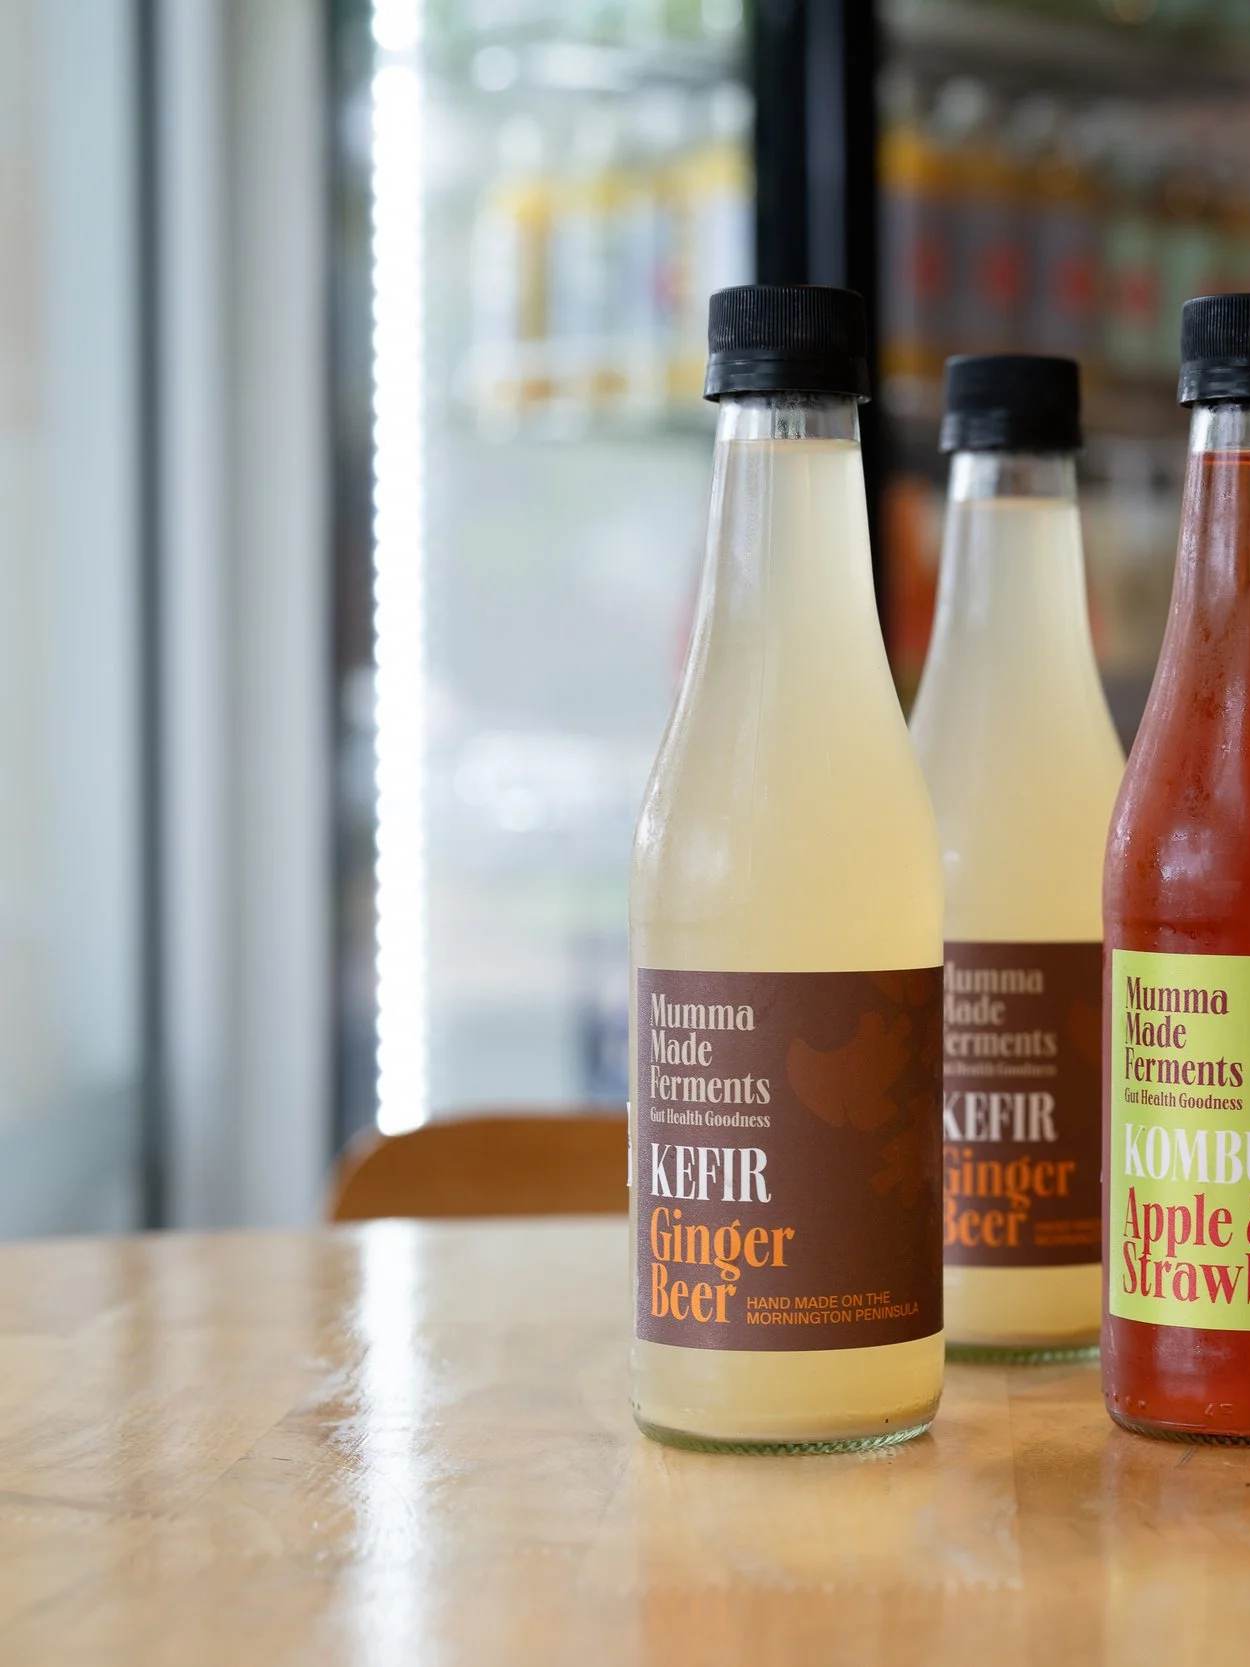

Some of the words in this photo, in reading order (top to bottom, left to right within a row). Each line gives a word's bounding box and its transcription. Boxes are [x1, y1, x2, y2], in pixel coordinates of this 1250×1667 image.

[650, 992, 755, 1030] Mumma
[1125, 975, 1229, 1016] Mumma
[650, 1029, 712, 1066] Made
[1125, 1011, 1187, 1049] Made
[650, 1065, 770, 1104] Ferments
[1124, 1047, 1243, 1088] Ferments
[650, 1106, 665, 1123] Gut
[667, 1108, 703, 1126] Health
[705, 1110, 771, 1128] Goodness
[1124, 1087, 1139, 1104] Gut
[1141, 1089, 1177, 1108] Health
[1179, 1092, 1243, 1111] Goodness
[650, 1142, 771, 1203] KEFIR
[1123, 1186, 1233, 1258] Apple
[650, 1206, 796, 1281] Ginger
[650, 1262, 737, 1323] Beer
[747, 1296, 791, 1310] HAND
[794, 1295, 838, 1309] MADE
[841, 1294, 863, 1308] ON
[865, 1291, 891, 1306] THE
[747, 1310, 852, 1325] MORNINGTON
[855, 1301, 920, 1322] PENINSULA
